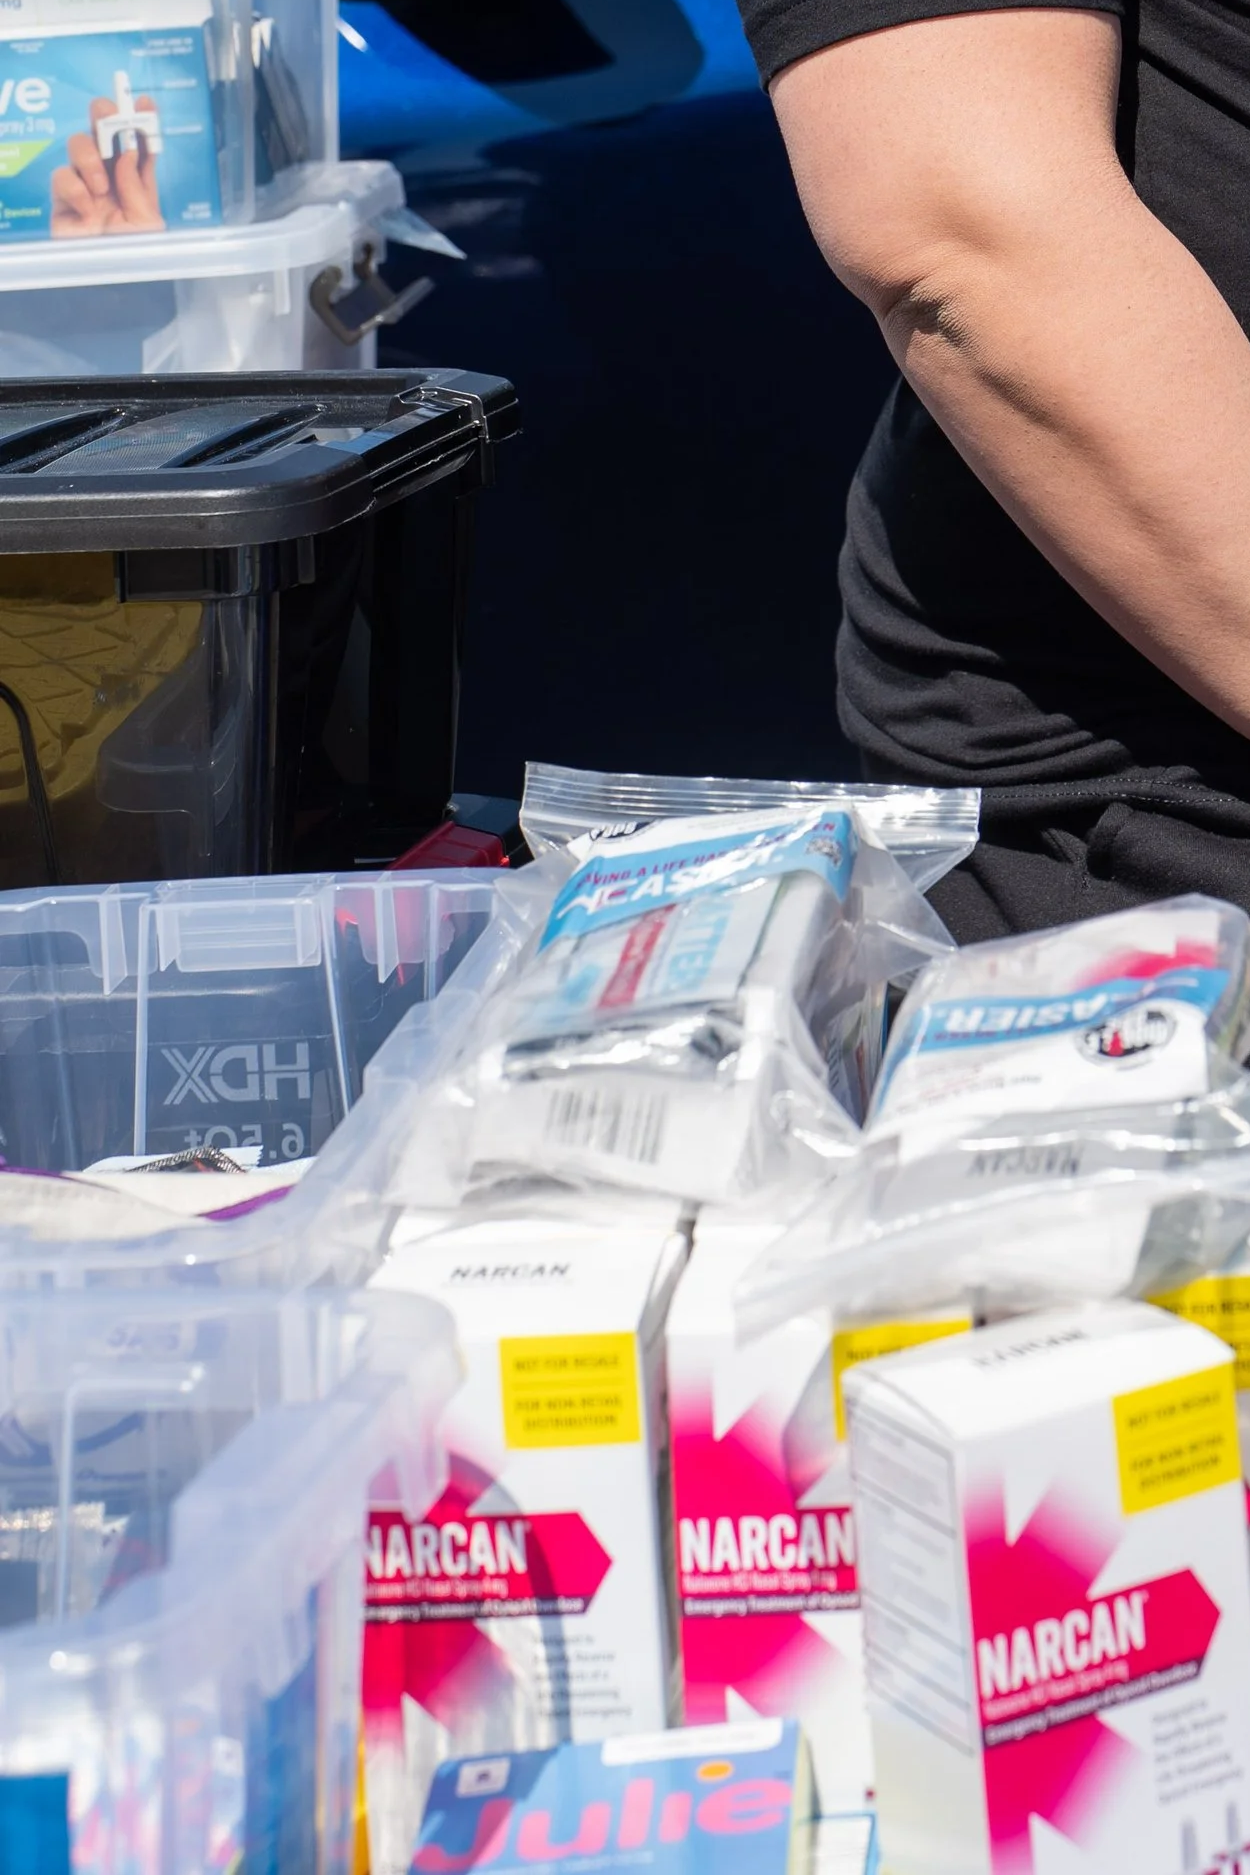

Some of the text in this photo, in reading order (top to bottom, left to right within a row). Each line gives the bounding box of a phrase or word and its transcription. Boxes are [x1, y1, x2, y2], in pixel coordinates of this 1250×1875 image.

[450, 1263, 572, 1281] NARCAN
[366, 1522, 528, 1580] NARCAN
[680, 1512, 858, 1574] NARCAN
[976, 1589, 1148, 1702] NARCAN
[411, 1760, 794, 1874] Julie
